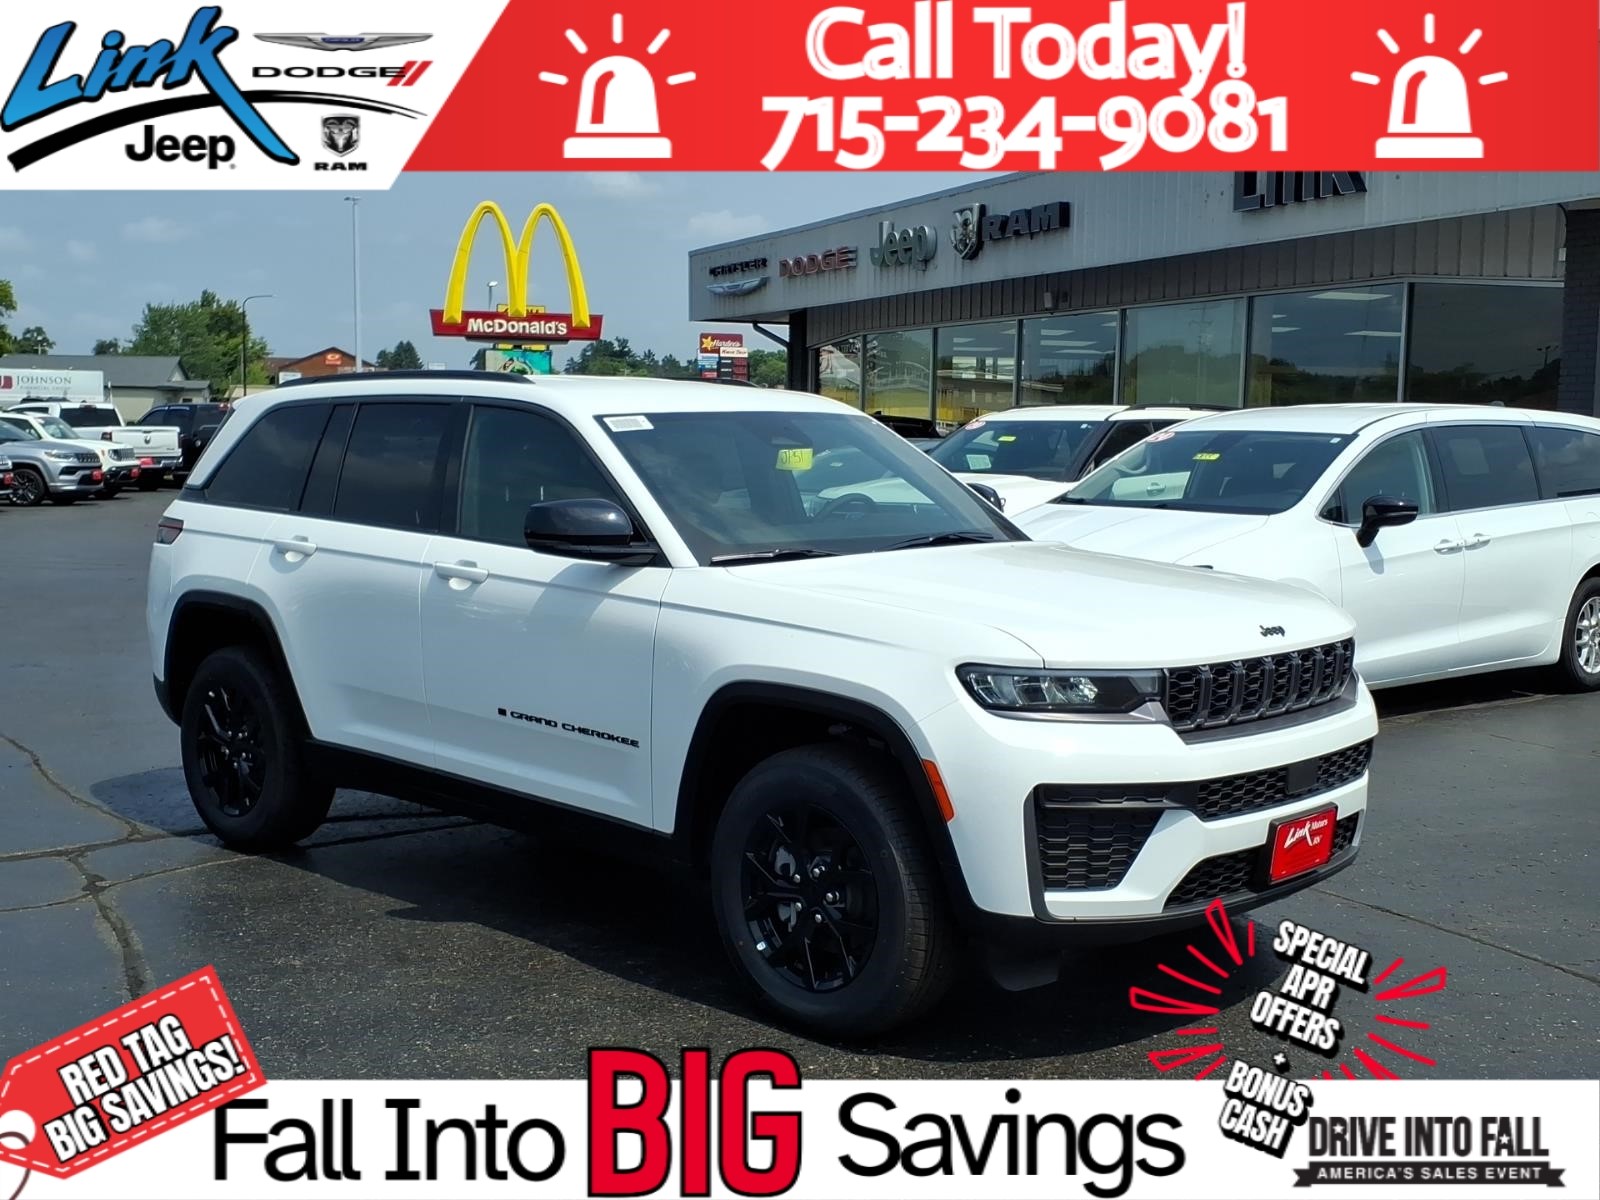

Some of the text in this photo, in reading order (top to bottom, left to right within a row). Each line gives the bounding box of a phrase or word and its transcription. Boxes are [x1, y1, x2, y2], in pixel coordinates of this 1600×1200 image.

[982, 201, 1070, 241] RAM
[870, 221, 937, 271] Jeep
[778, 246, 858, 278] DODGE
[467, 318, 567, 335] McDonald's
[17, 375, 72, 385] JOHNSON
[1259, 625, 1285, 637] Jeep
[510, 711, 640, 748] GRAND CHEROKEE
[1284, 821, 1313, 849] Link
